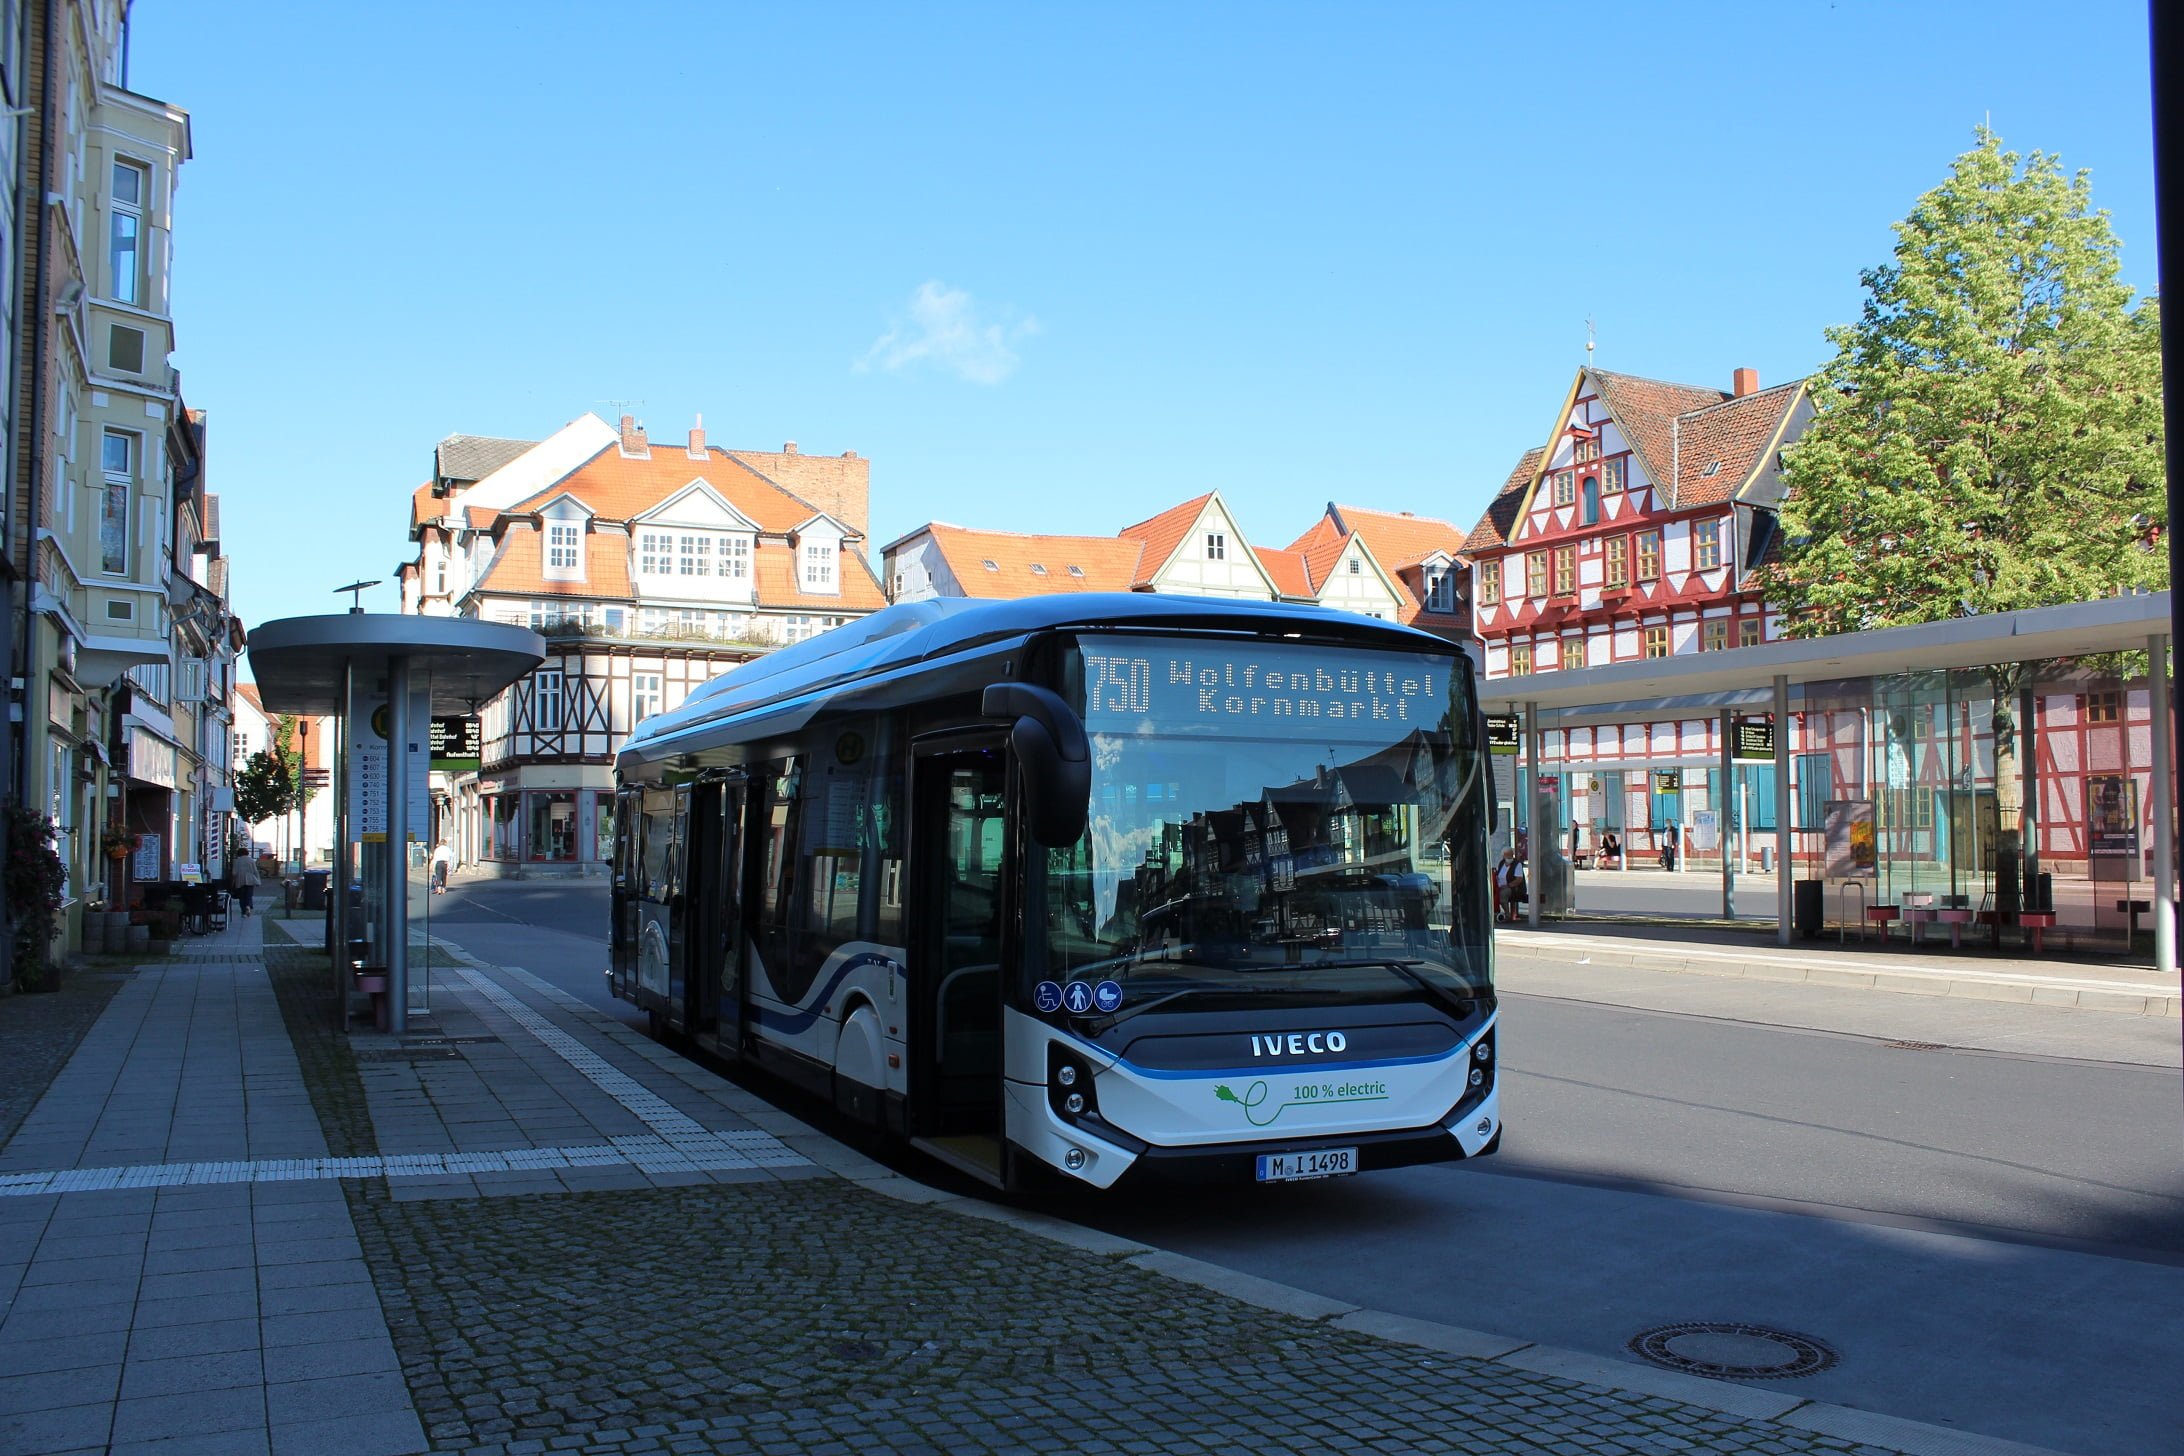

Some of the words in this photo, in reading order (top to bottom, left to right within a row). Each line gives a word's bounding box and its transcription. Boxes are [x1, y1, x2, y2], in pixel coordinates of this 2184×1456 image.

[1087, 655, 1150, 713] 750
[1169, 659, 1434, 697] Wolfenbüttel
[1198, 688, 1409, 720] Kornmarkt
[1251, 1031, 1347, 1057] IVECO
[1294, 1085, 1319, 1100] 100
[1322, 1083, 1334, 1098] %
[1337, 1080, 1386, 1097] electric
[1272, 1157, 1284, 1177] M
[1295, 1156, 1304, 1174] I
[1308, 1152, 1349, 1173] 1498
